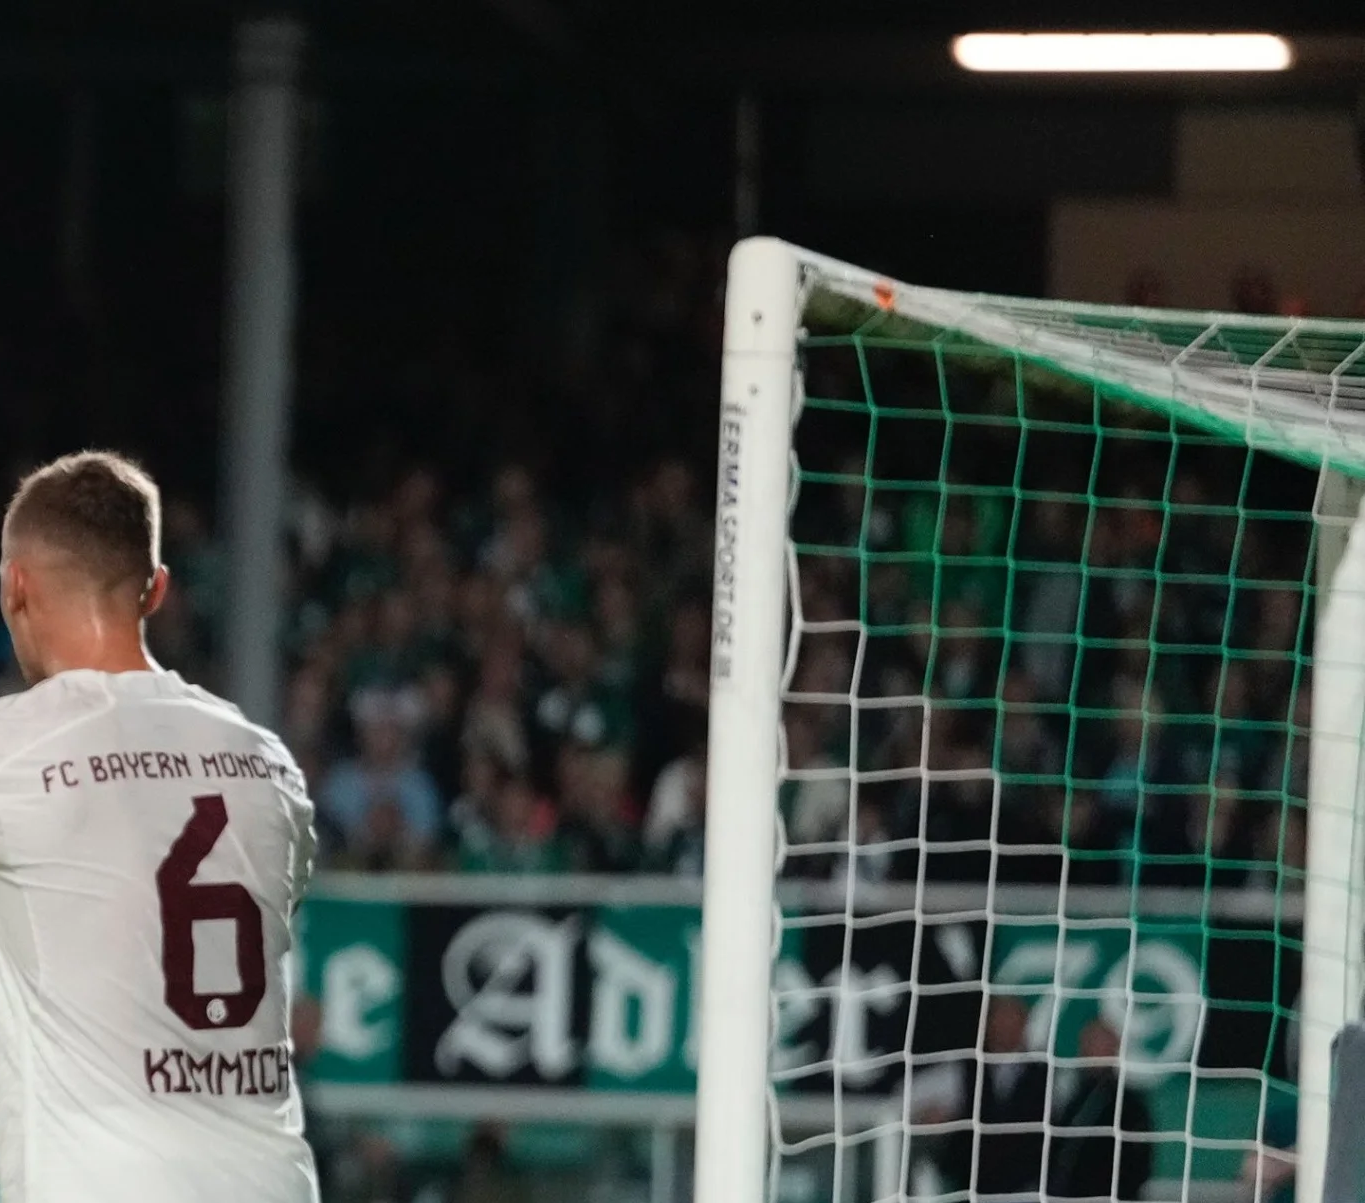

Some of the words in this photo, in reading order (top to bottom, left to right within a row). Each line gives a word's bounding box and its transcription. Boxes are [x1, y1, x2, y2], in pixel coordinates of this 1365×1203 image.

[41, 760, 79, 793] FC
[88, 752, 192, 784] BAYERN
[155, 792, 267, 1031] 6
[143, 1046, 290, 1097] KIMMICH
